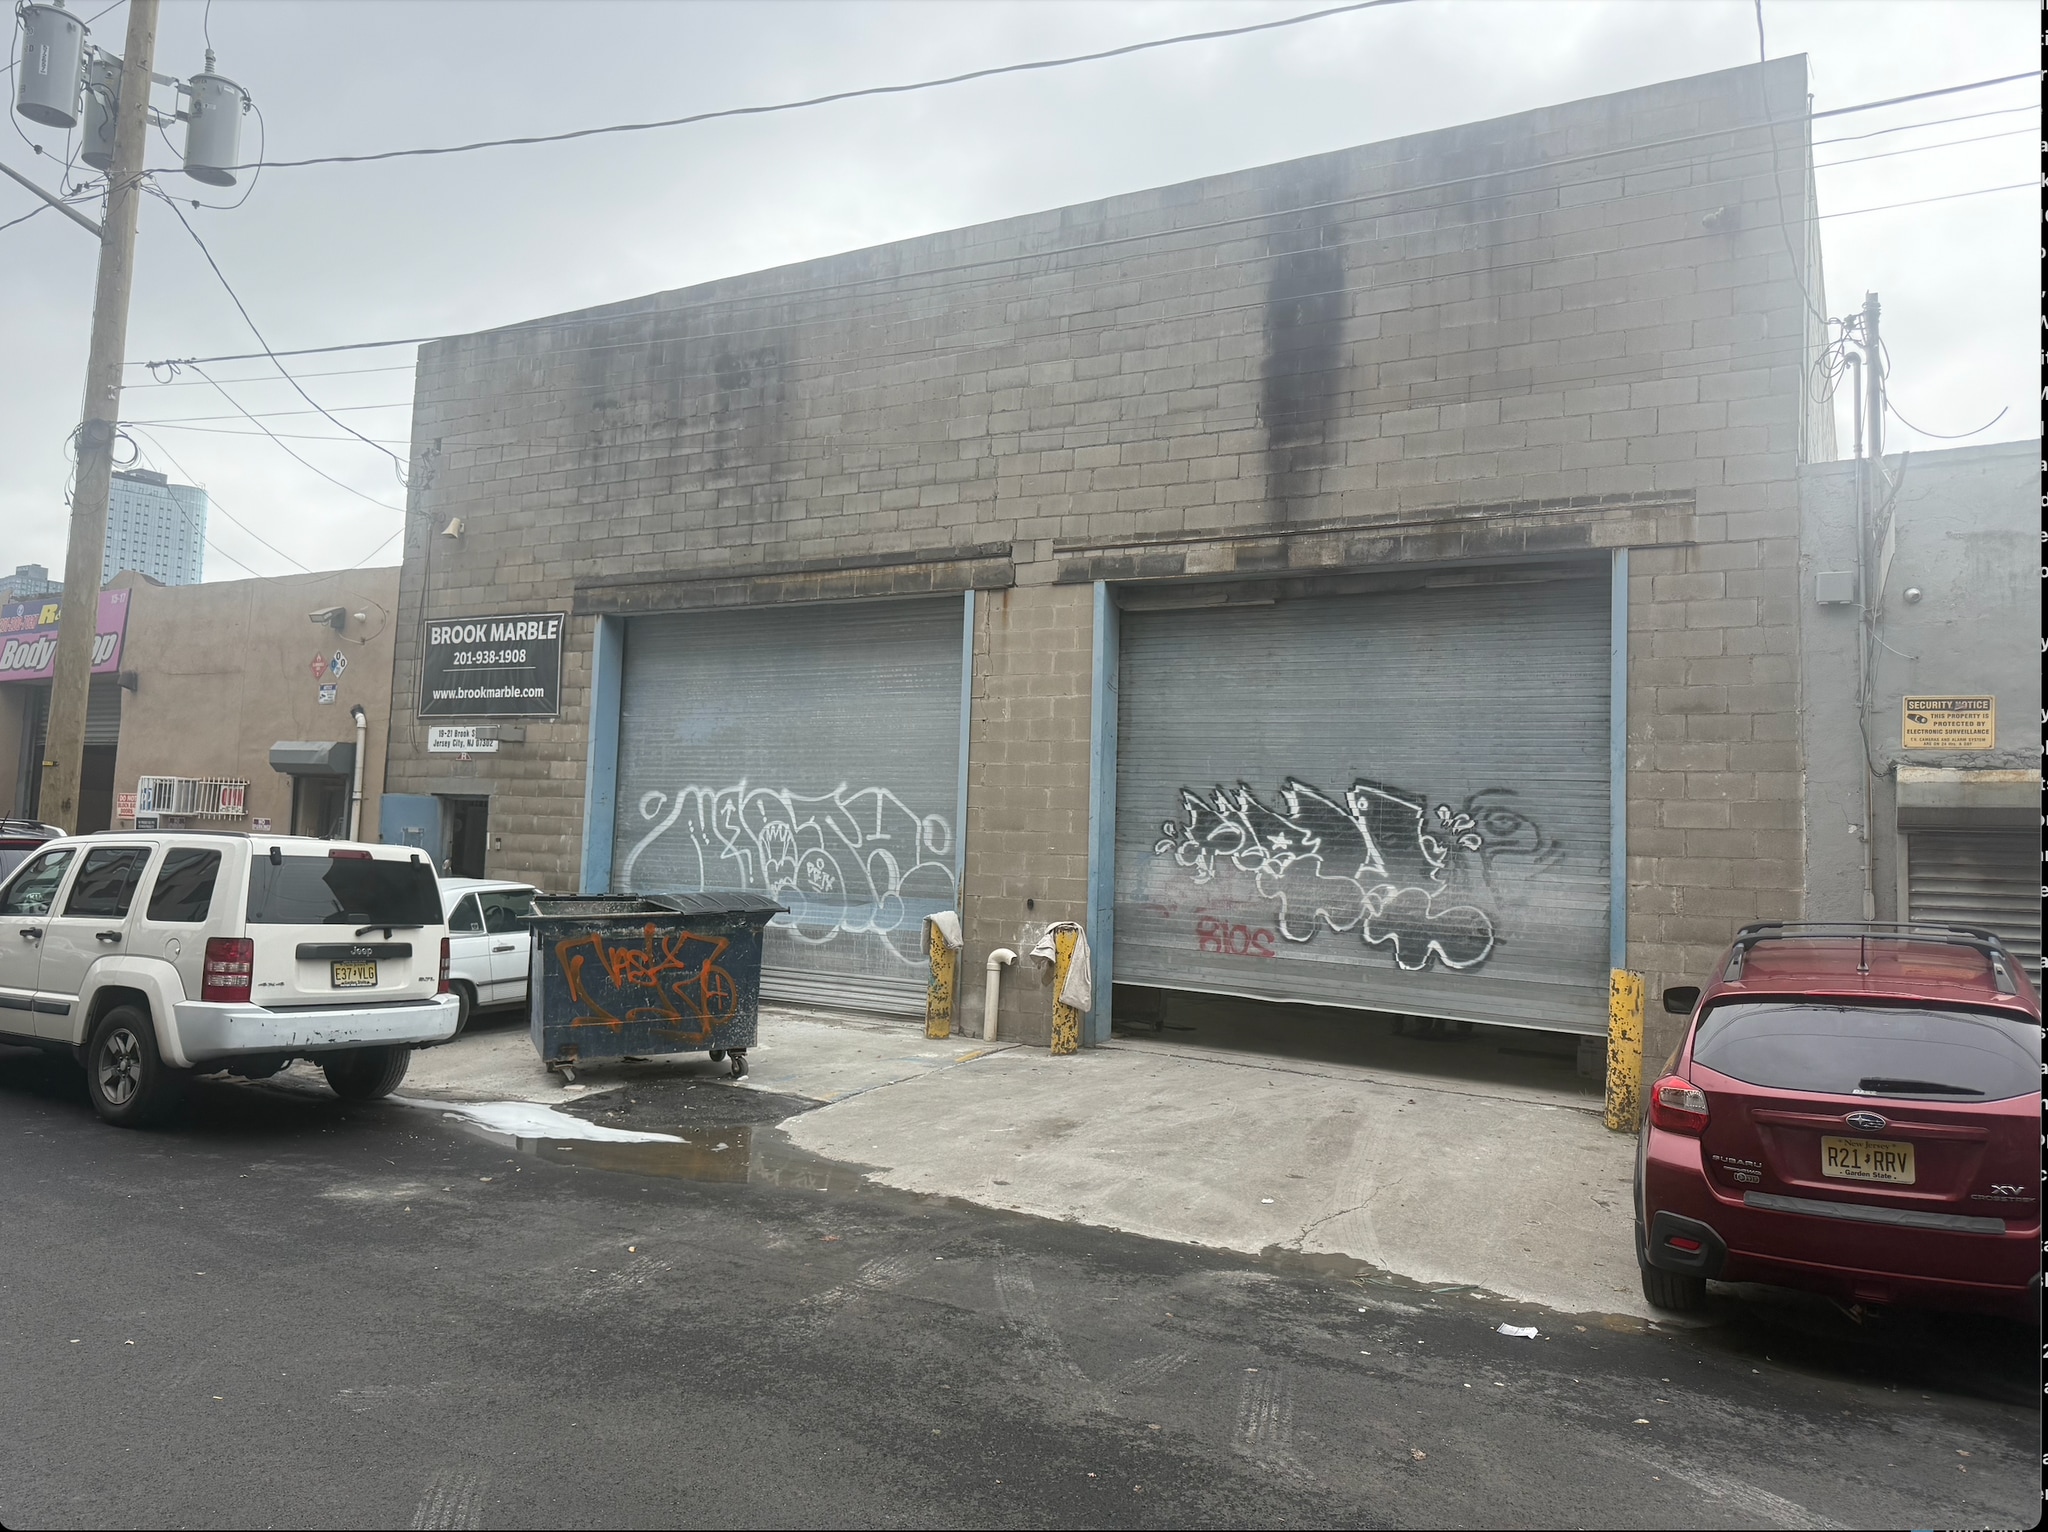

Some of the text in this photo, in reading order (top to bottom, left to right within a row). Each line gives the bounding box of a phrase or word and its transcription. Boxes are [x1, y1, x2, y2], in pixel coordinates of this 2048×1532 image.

[431, 620, 559, 645] BROOK MARBLE
[0, 636, 57, 671] Body
[453, 649, 527, 665] 201-938-1908
[432, 686, 544, 700] www.brookmarble.com
[1908, 700, 1953, 709] SECURITY
[454, 729, 469, 738] Brook
[433, 739, 451, 748] Jersey
[452, 739, 465, 748] City,
[467, 739, 474, 747] NJ
[350, 946, 373, 957] Jeep
[335, 966, 374, 980] E37 VLG
[1844, 1139, 1890, 1150] New Jersey
[1712, 1154, 1762, 1168] SUBARU
[1828, 1147, 1907, 1173] R21 RRV
[1845, 1169, 1892, 1180] Garden State
[1991, 1184, 2025, 1196] XV
[1970, 1194, 2036, 1203] CROSSTREK
